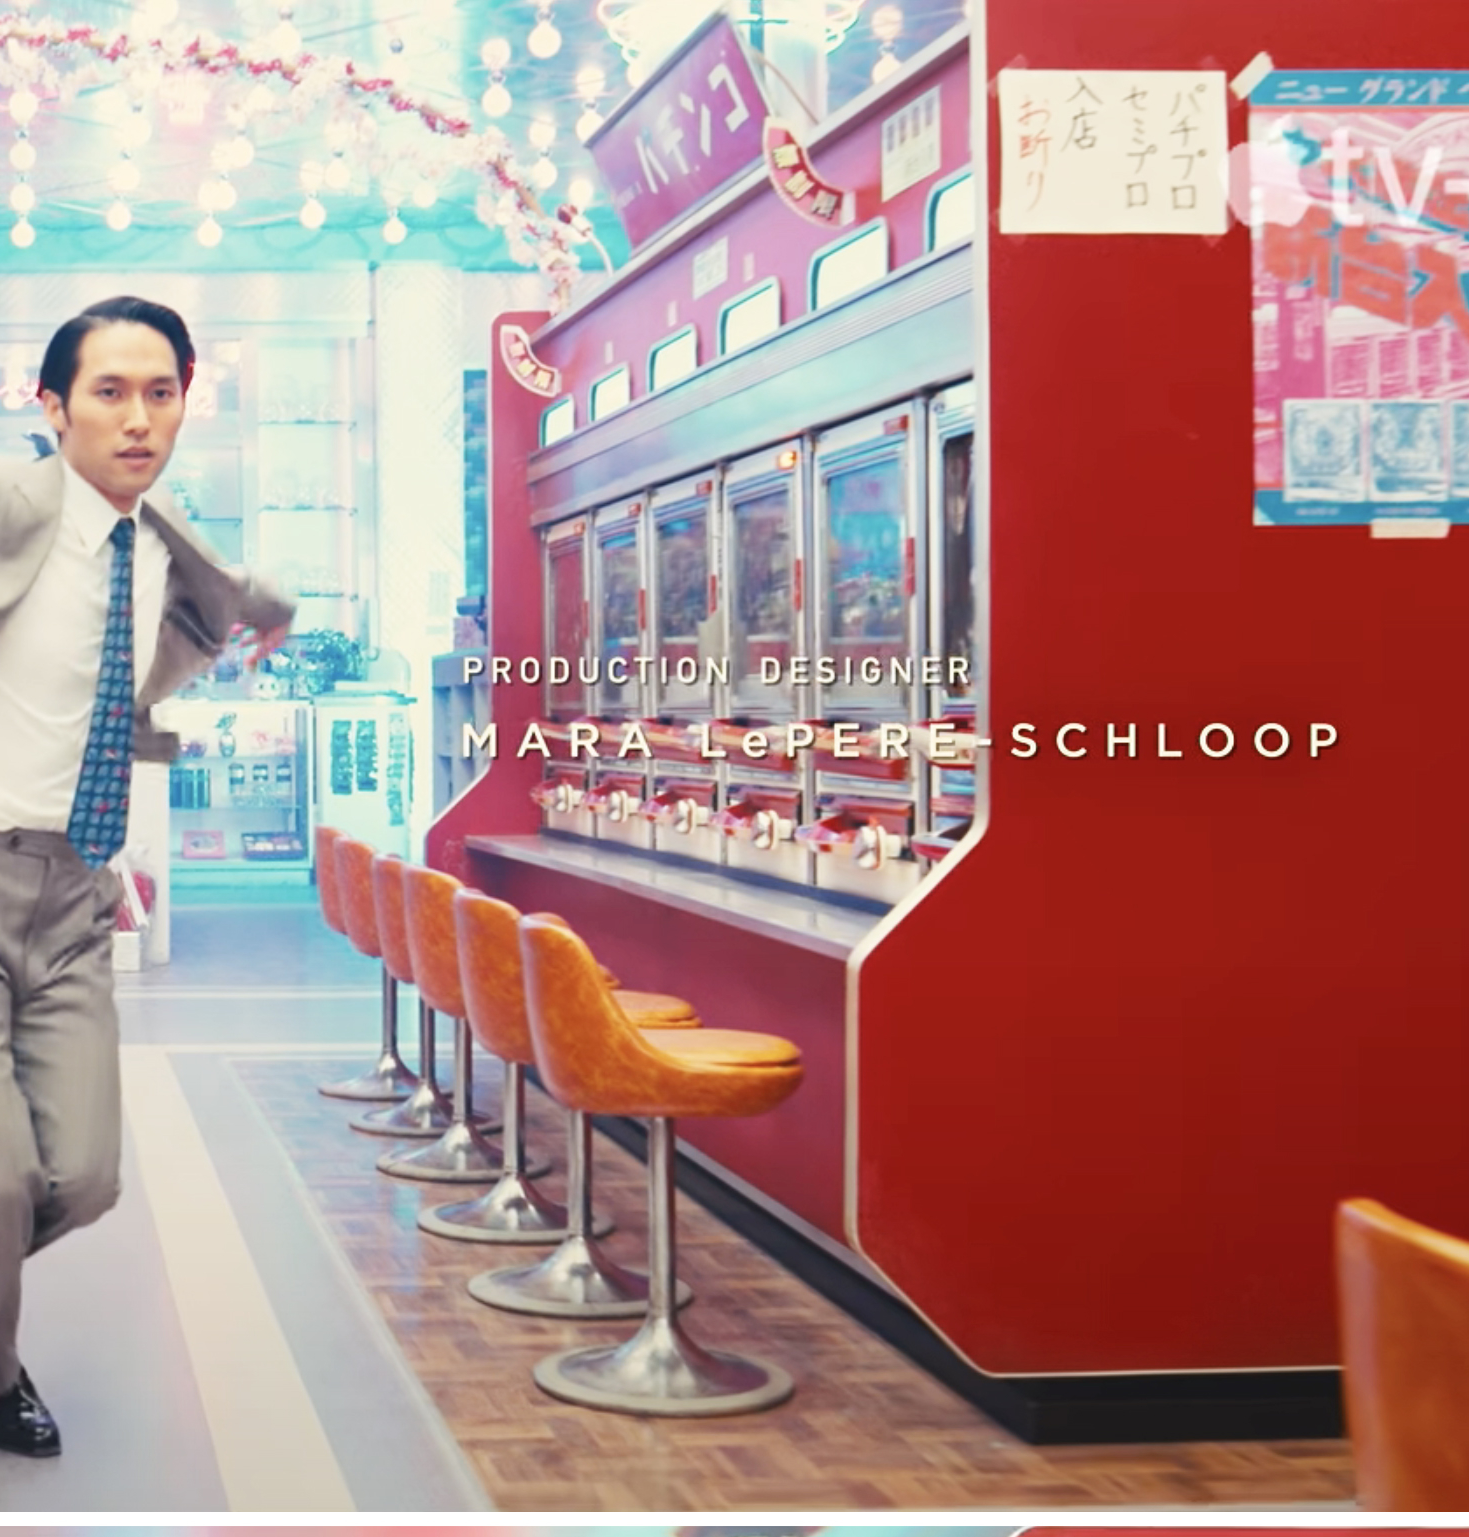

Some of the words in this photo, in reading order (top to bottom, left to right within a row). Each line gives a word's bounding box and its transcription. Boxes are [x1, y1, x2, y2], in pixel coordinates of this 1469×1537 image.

[1017, 97, 1053, 213] お断り
[1061, 77, 1104, 152] 入店
[1122, 86, 1158, 209] セミプロ
[1169, 84, 1207, 212] パチプロ
